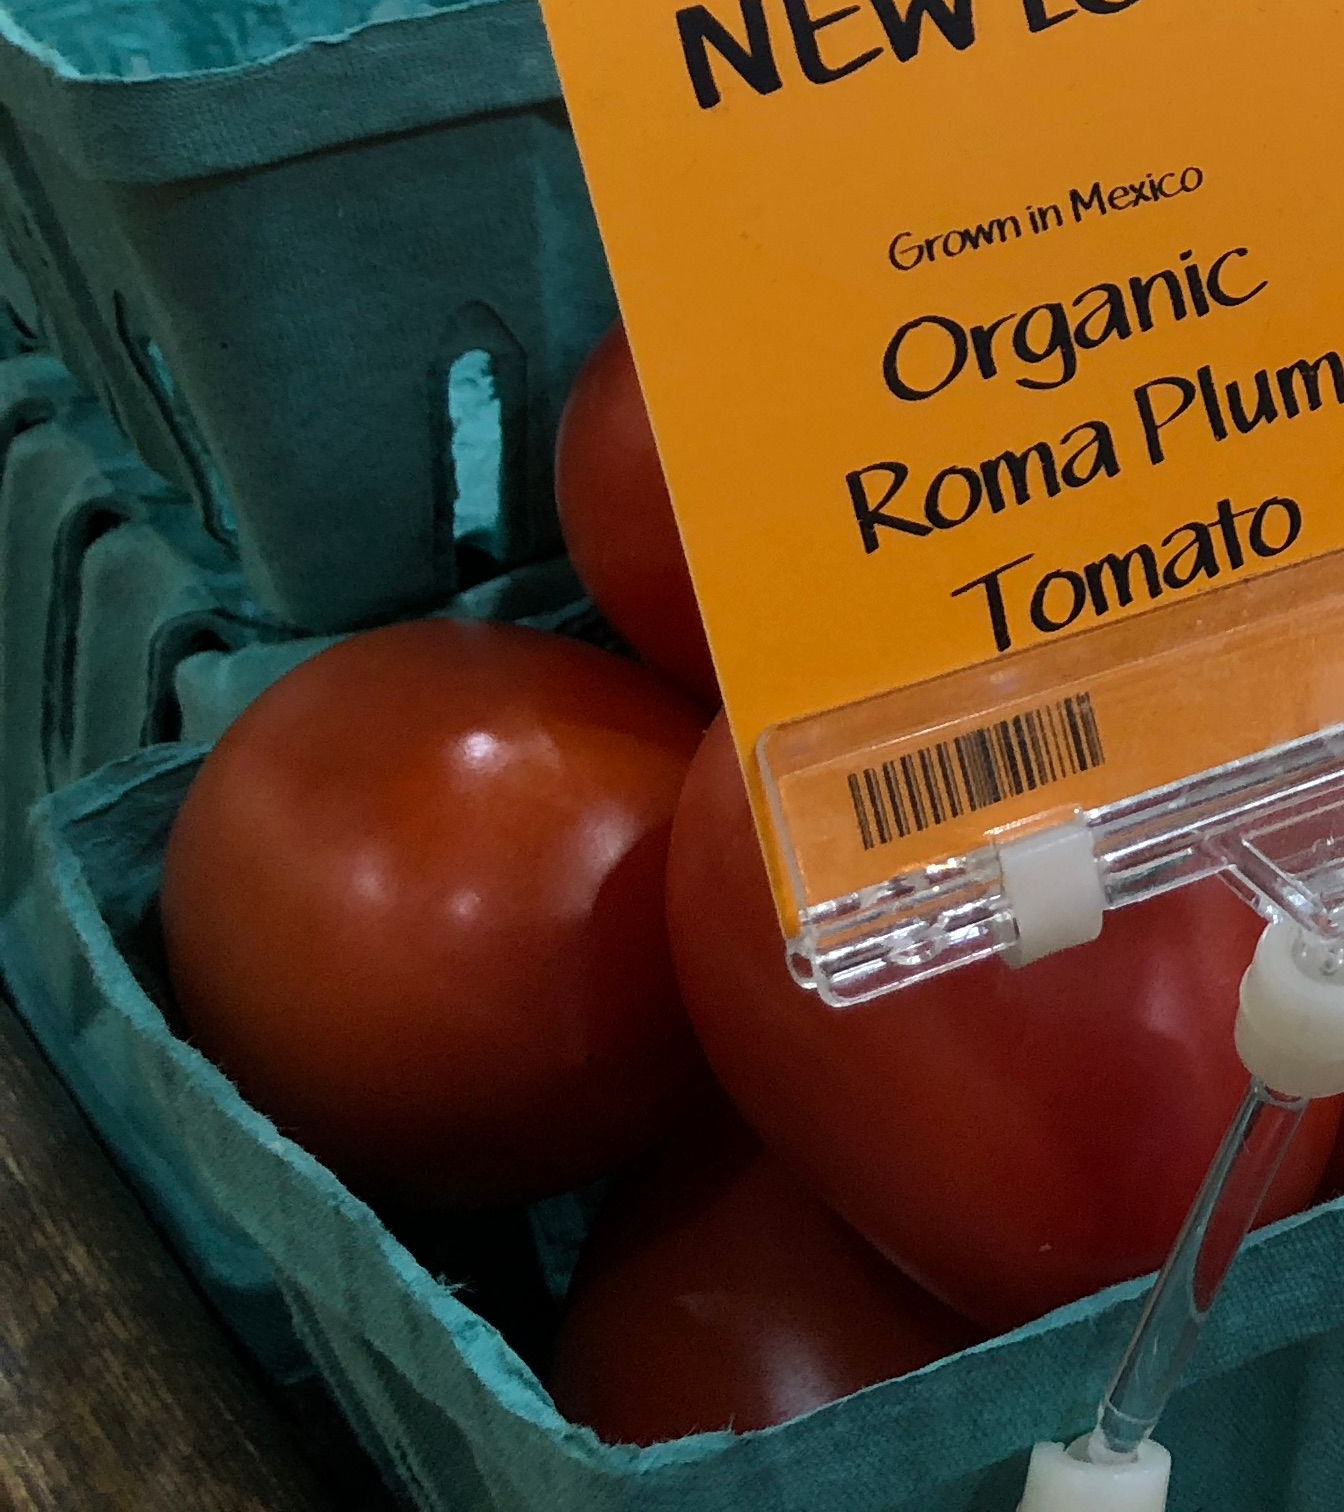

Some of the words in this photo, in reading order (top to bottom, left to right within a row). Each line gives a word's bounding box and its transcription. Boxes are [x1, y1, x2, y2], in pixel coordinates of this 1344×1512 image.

[888, 215, 1022, 272] Grown
[1025, 202, 1064, 235] in
[1068, 166, 1204, 223] Mexico
[882, 247, 1269, 402] Organic
[845, 420, 1121, 555] Roma
[950, 495, 1302, 653] Tomato
